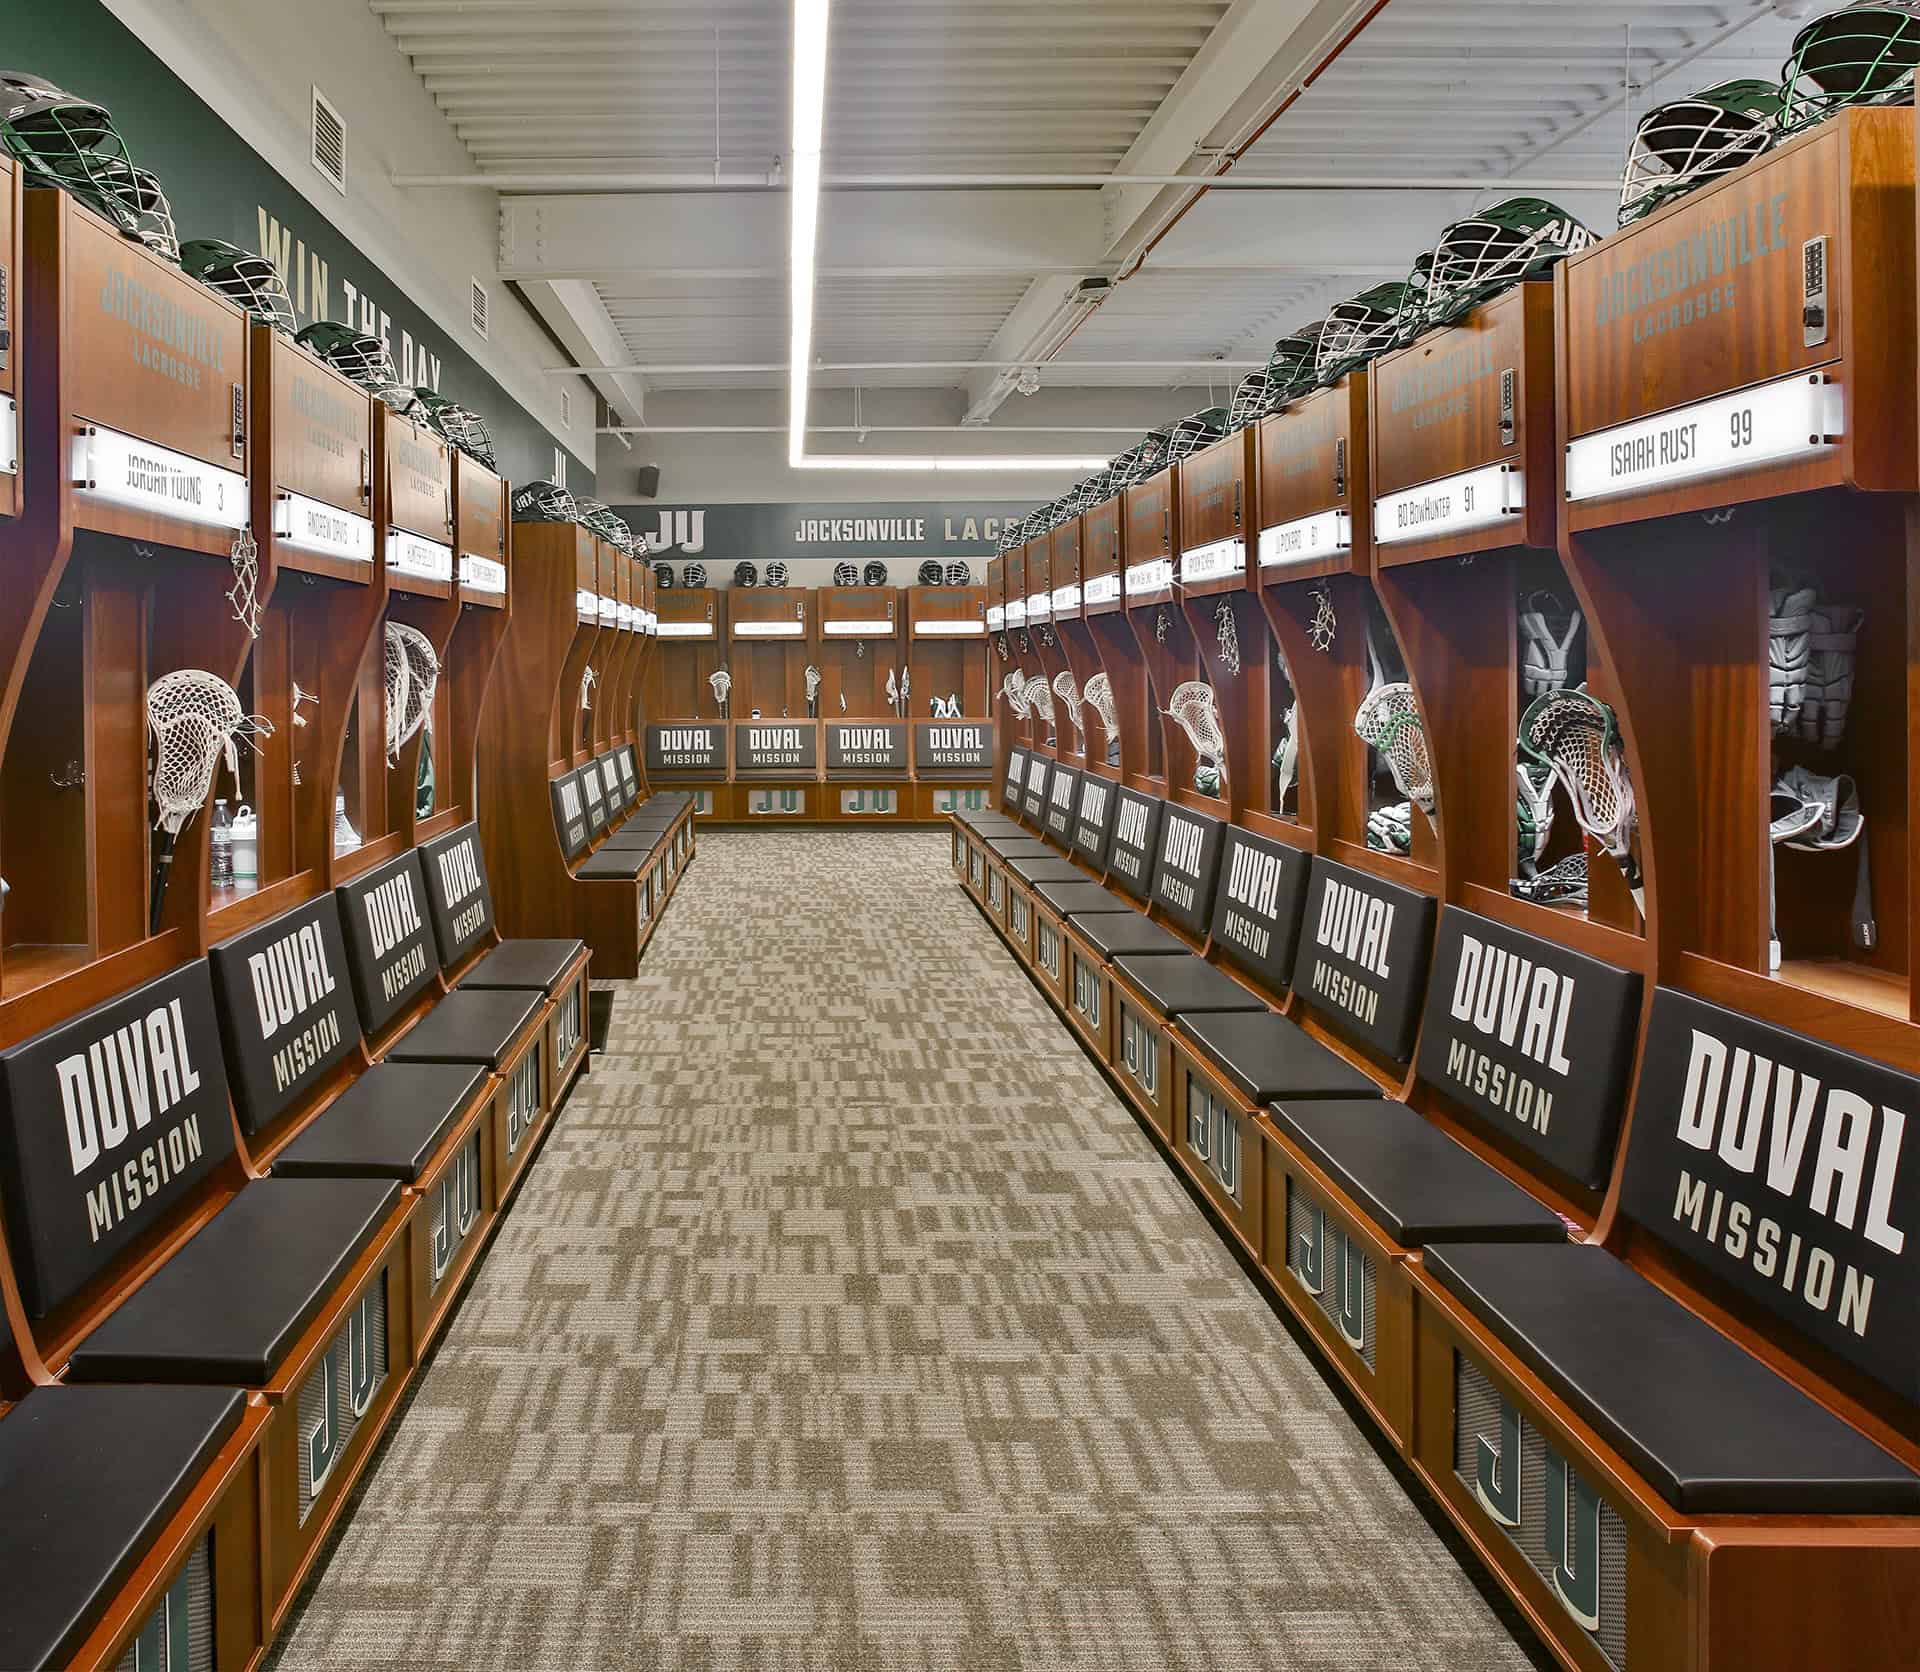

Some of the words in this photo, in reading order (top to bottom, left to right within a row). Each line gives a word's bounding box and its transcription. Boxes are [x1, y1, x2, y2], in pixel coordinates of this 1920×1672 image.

[1594, 191, 1790, 327] JACKSONVILLE
[101, 265, 225, 374] JACKSONVILLE
[257, 204, 329, 321] WIN
[344, 278, 391, 364] THE
[402, 329, 441, 394] DAY
[1631, 282, 1737, 344] LACROSSE
[1610, 435, 1655, 477] ISAIAH
[1660, 423, 1698, 465] RUST
[1730, 409, 1753, 448] 99
[126, 453, 168, 496] JORDAN
[170, 467, 202, 505] YOUNG
[217, 482, 224, 511] 3
[1464, 486, 1475, 512] 91
[645, 511, 706, 553] JU
[795, 518, 925, 542] JACKSONVILLE
[660, 729, 714, 751] DUVAL
[663, 753, 711, 764] MISSION
[749, 728, 804, 750] DUVAL
[752, 753, 800, 763] MISSION
[839, 728, 894, 750] DUVAL
[843, 753, 890, 763] MISSION
[929, 728, 984, 749] DUVAL
[933, 752, 981, 762] MISSION
[1117, 797, 1149, 850] DUVAL
[1164, 815, 1205, 879] DUVAL
[438, 837, 481, 909] DUVAL
[1161, 873, 1195, 912] MISSION
[1228, 842, 1282, 921] DUVAL
[363, 870, 422, 960] DUVAL
[452, 899, 486, 944] MISSION
[1224, 909, 1270, 959] MISSION
[1316, 877, 1396, 979] DUVAL
[248, 919, 336, 1040] DUVAL
[381, 943, 427, 1002] MISSION
[1312, 959, 1379, 1026] MISSION
[1450, 933, 1575, 1076] DUVAL
[272, 1010, 341, 1093] MISSION
[56, 997, 200, 1176] DUVAL
[1446, 1037, 1553, 1136] MISSION
[1192, 1085, 1238, 1195] JU
[1676, 1028, 1906, 1255] DUVAL
[86, 1113, 203, 1243] MISSION
[1299, 1200, 1367, 1351] JU
[1673, 1169, 1875, 1337] MISSION
[310, 1297, 377, 1498] JU
[1475, 1395, 1603, 1632] JU
